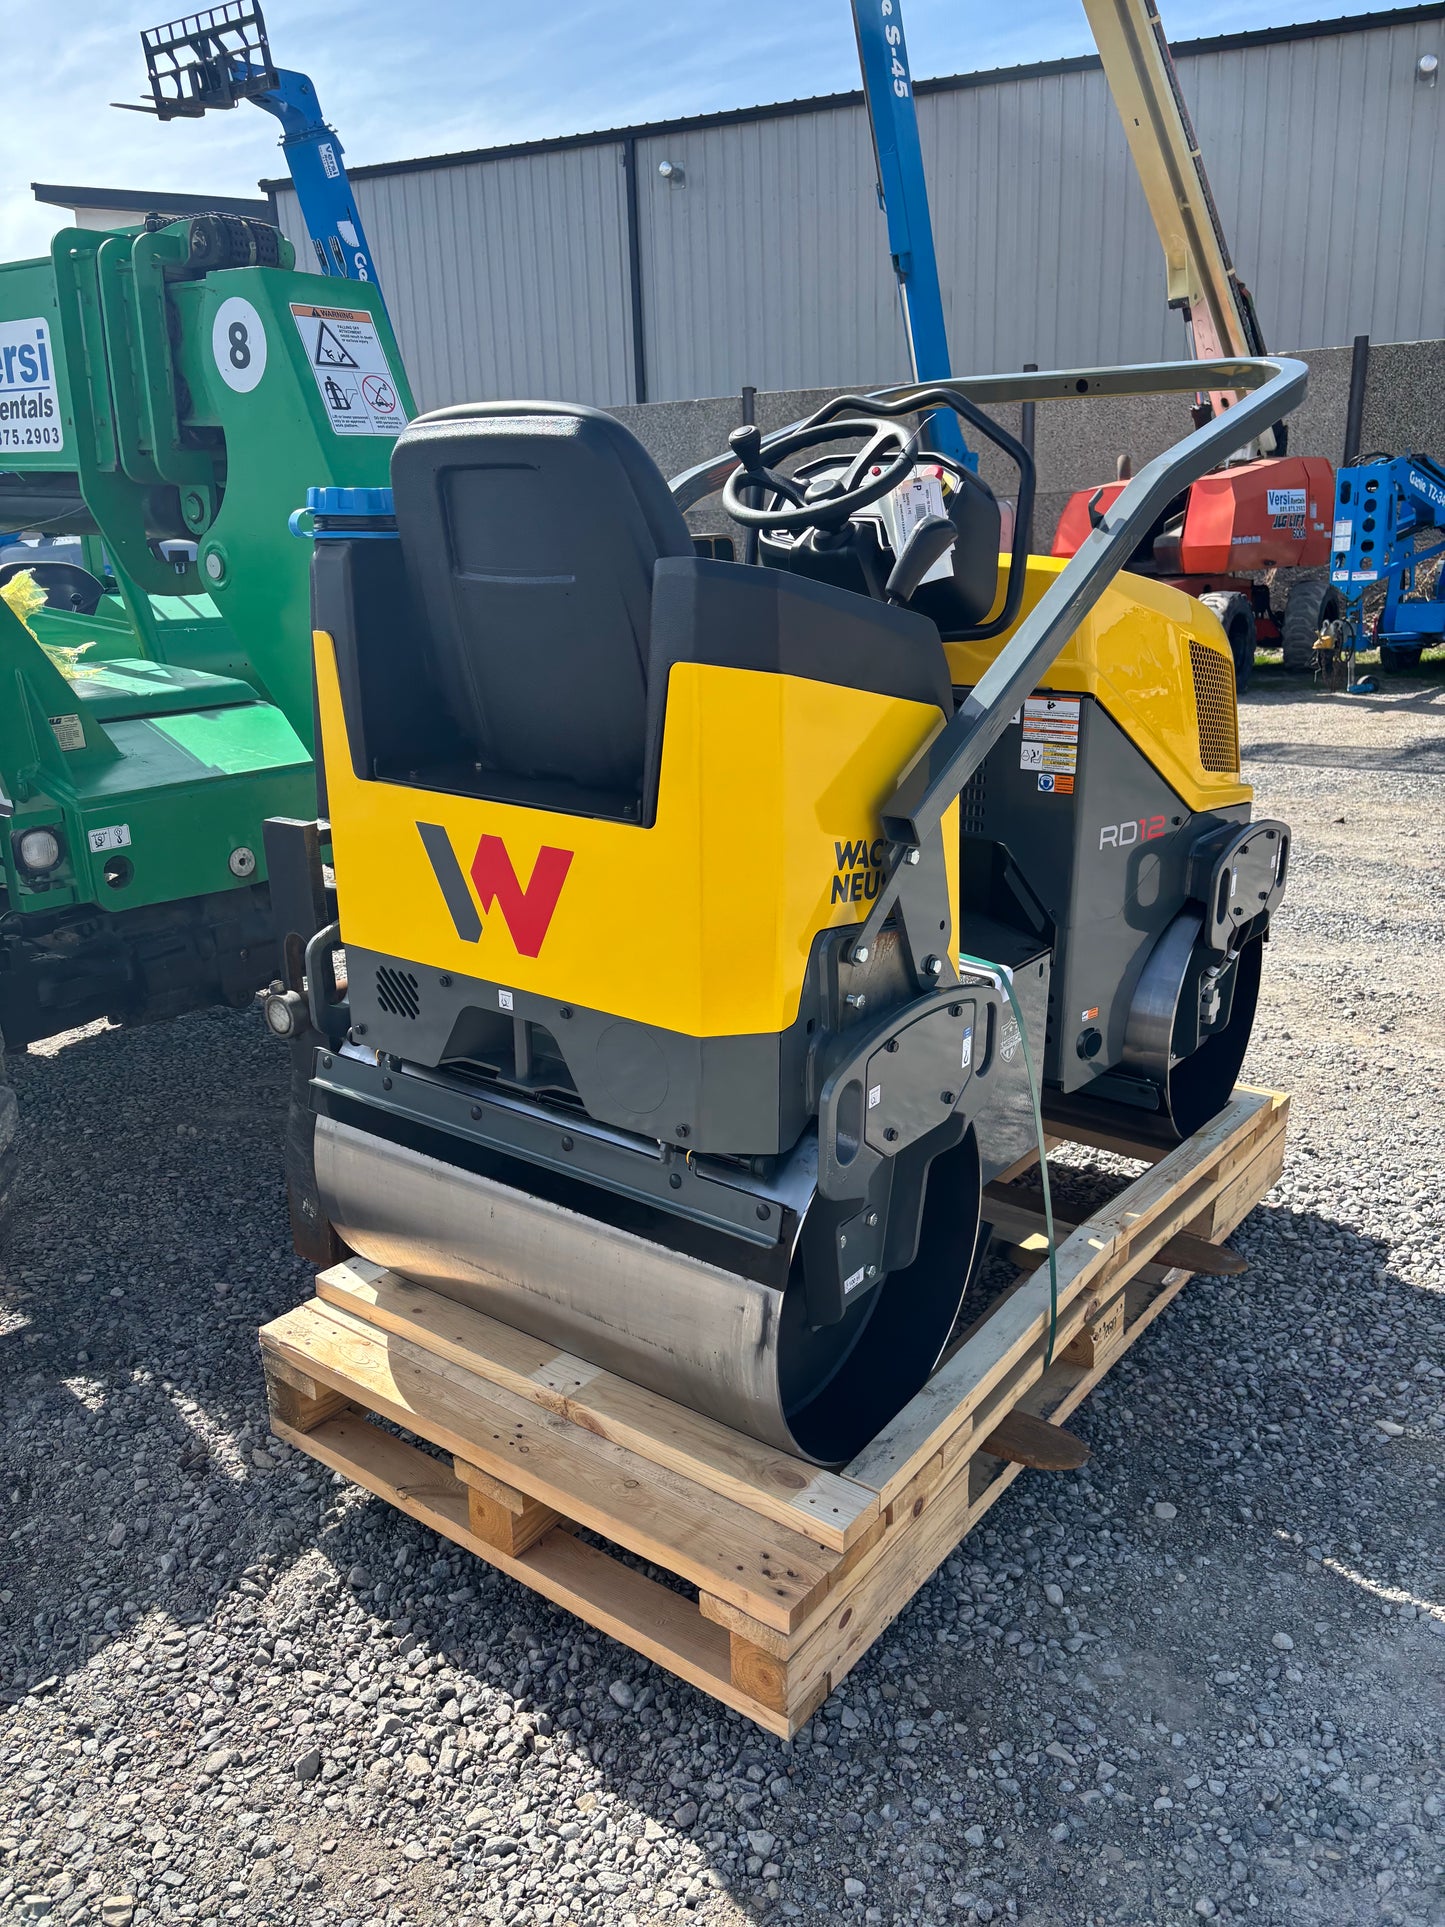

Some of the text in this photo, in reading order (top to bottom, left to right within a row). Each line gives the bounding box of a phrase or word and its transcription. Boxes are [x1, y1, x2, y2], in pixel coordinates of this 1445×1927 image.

[885, 24, 909, 98] S-45
[320, 309, 353, 320] WARNING
[0, 328, 50, 384] rsi
[229, 322, 250, 369] 8
[0, 427, 60, 446] 75.2903
[1410, 471, 1426, 494] Genie
[1268, 491, 1290, 506] Versi
[1273, 514, 1306, 529] JLG LIFT
[1099, 815, 1166, 850] RD12
